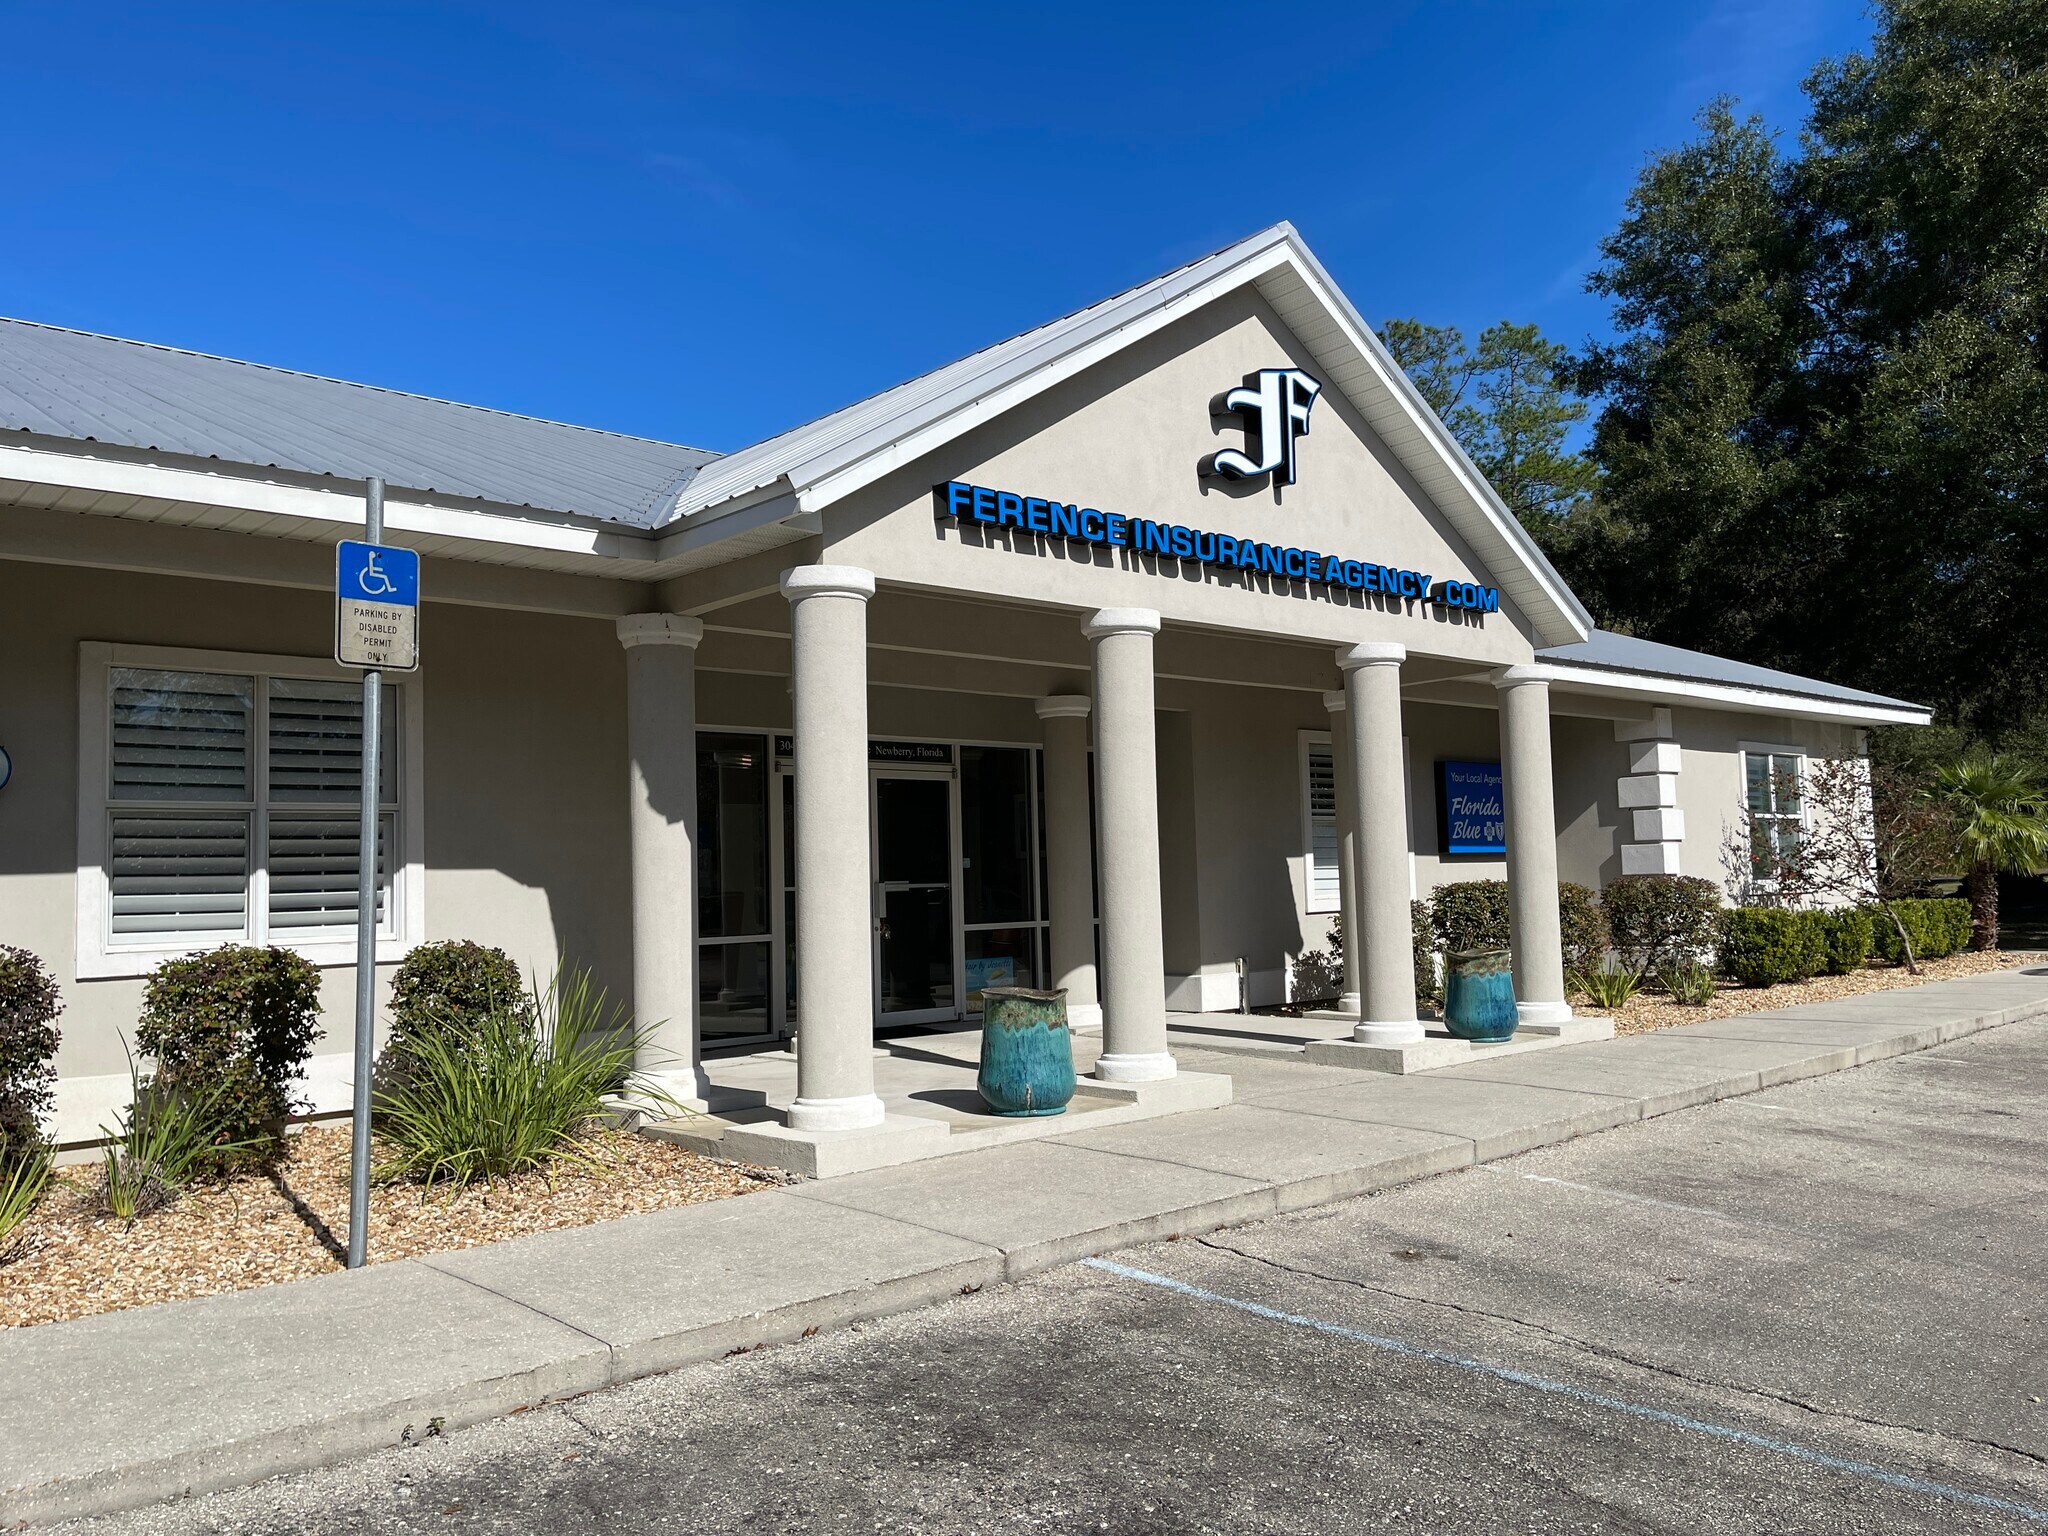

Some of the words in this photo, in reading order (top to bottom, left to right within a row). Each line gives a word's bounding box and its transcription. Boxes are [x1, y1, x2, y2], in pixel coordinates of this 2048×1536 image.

[947, 480, 1127, 546] FERENCE
[1133, 517, 1321, 580] INSURANCE
[354, 607, 388, 620] PARKING
[392, 609, 402, 621] BY
[359, 622, 397, 635] DISABLED
[363, 637, 392, 648] PERMIT
[367, 651, 387, 662] ONLY
[875, 745, 915, 759] Newberry,
[917, 747, 943, 757] Florida
[1450, 772, 1465, 783] Your
[1466, 773, 1482, 783] Local
[1483, 774, 1503, 786] Agenc
[1451, 795, 1502, 816] Florida
[1452, 819, 1481, 839] Blue
